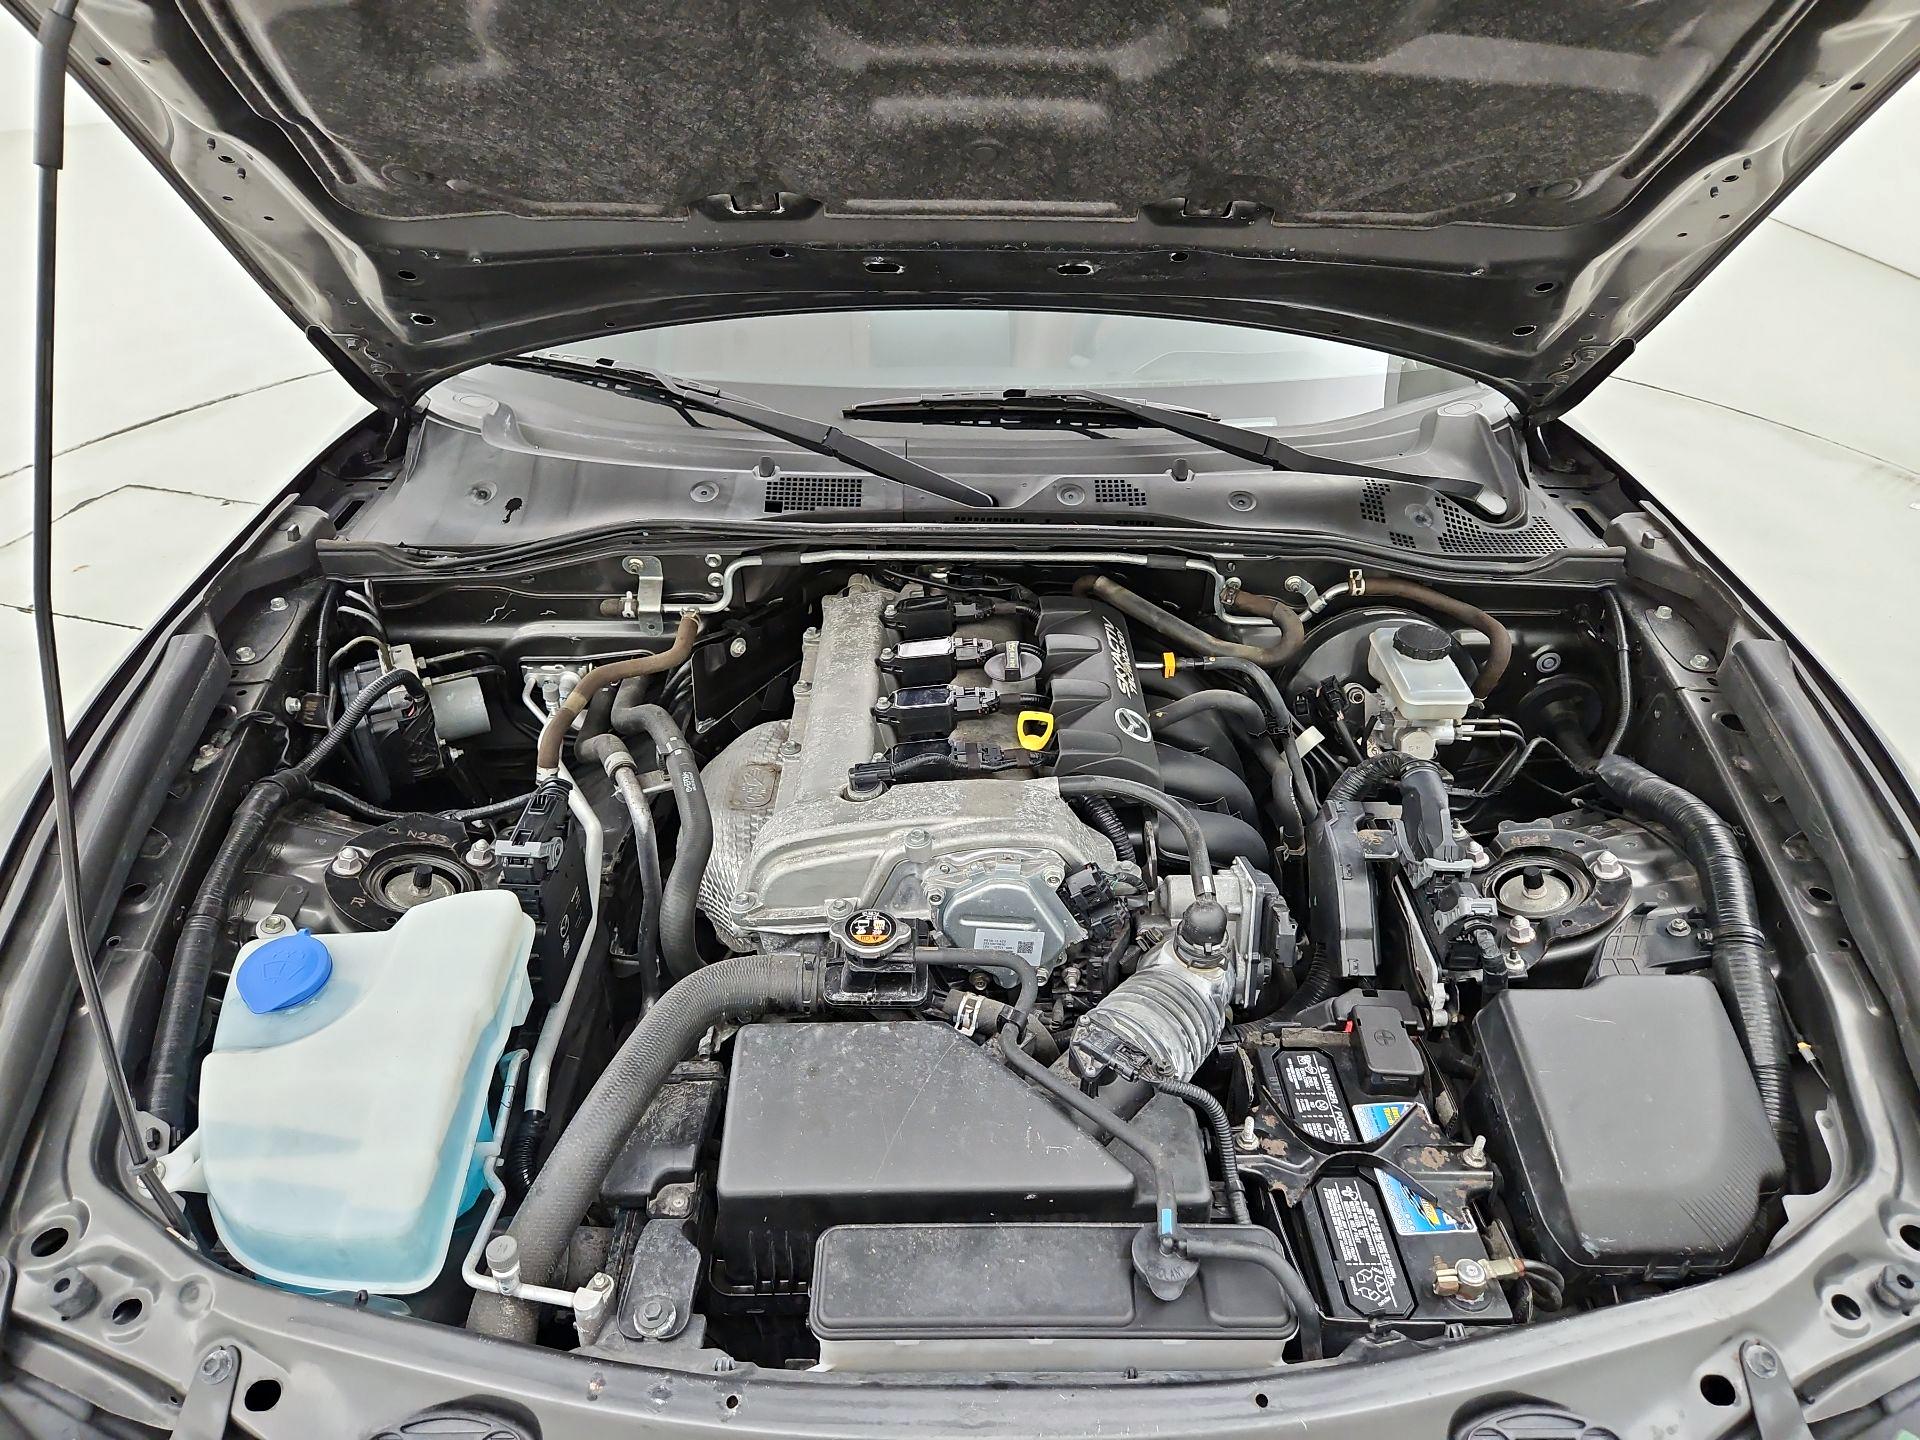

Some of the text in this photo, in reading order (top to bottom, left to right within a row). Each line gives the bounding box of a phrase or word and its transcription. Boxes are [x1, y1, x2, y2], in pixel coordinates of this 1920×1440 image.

[1103, 616, 1131, 699] SKYACTIV
[1115, 627, 1138, 694] TECHNOLOGY
[350, 897, 366, 907] R
[1322, 1073, 1338, 1104] DANGER
[1335, 1111, 1351, 1141] POISON
